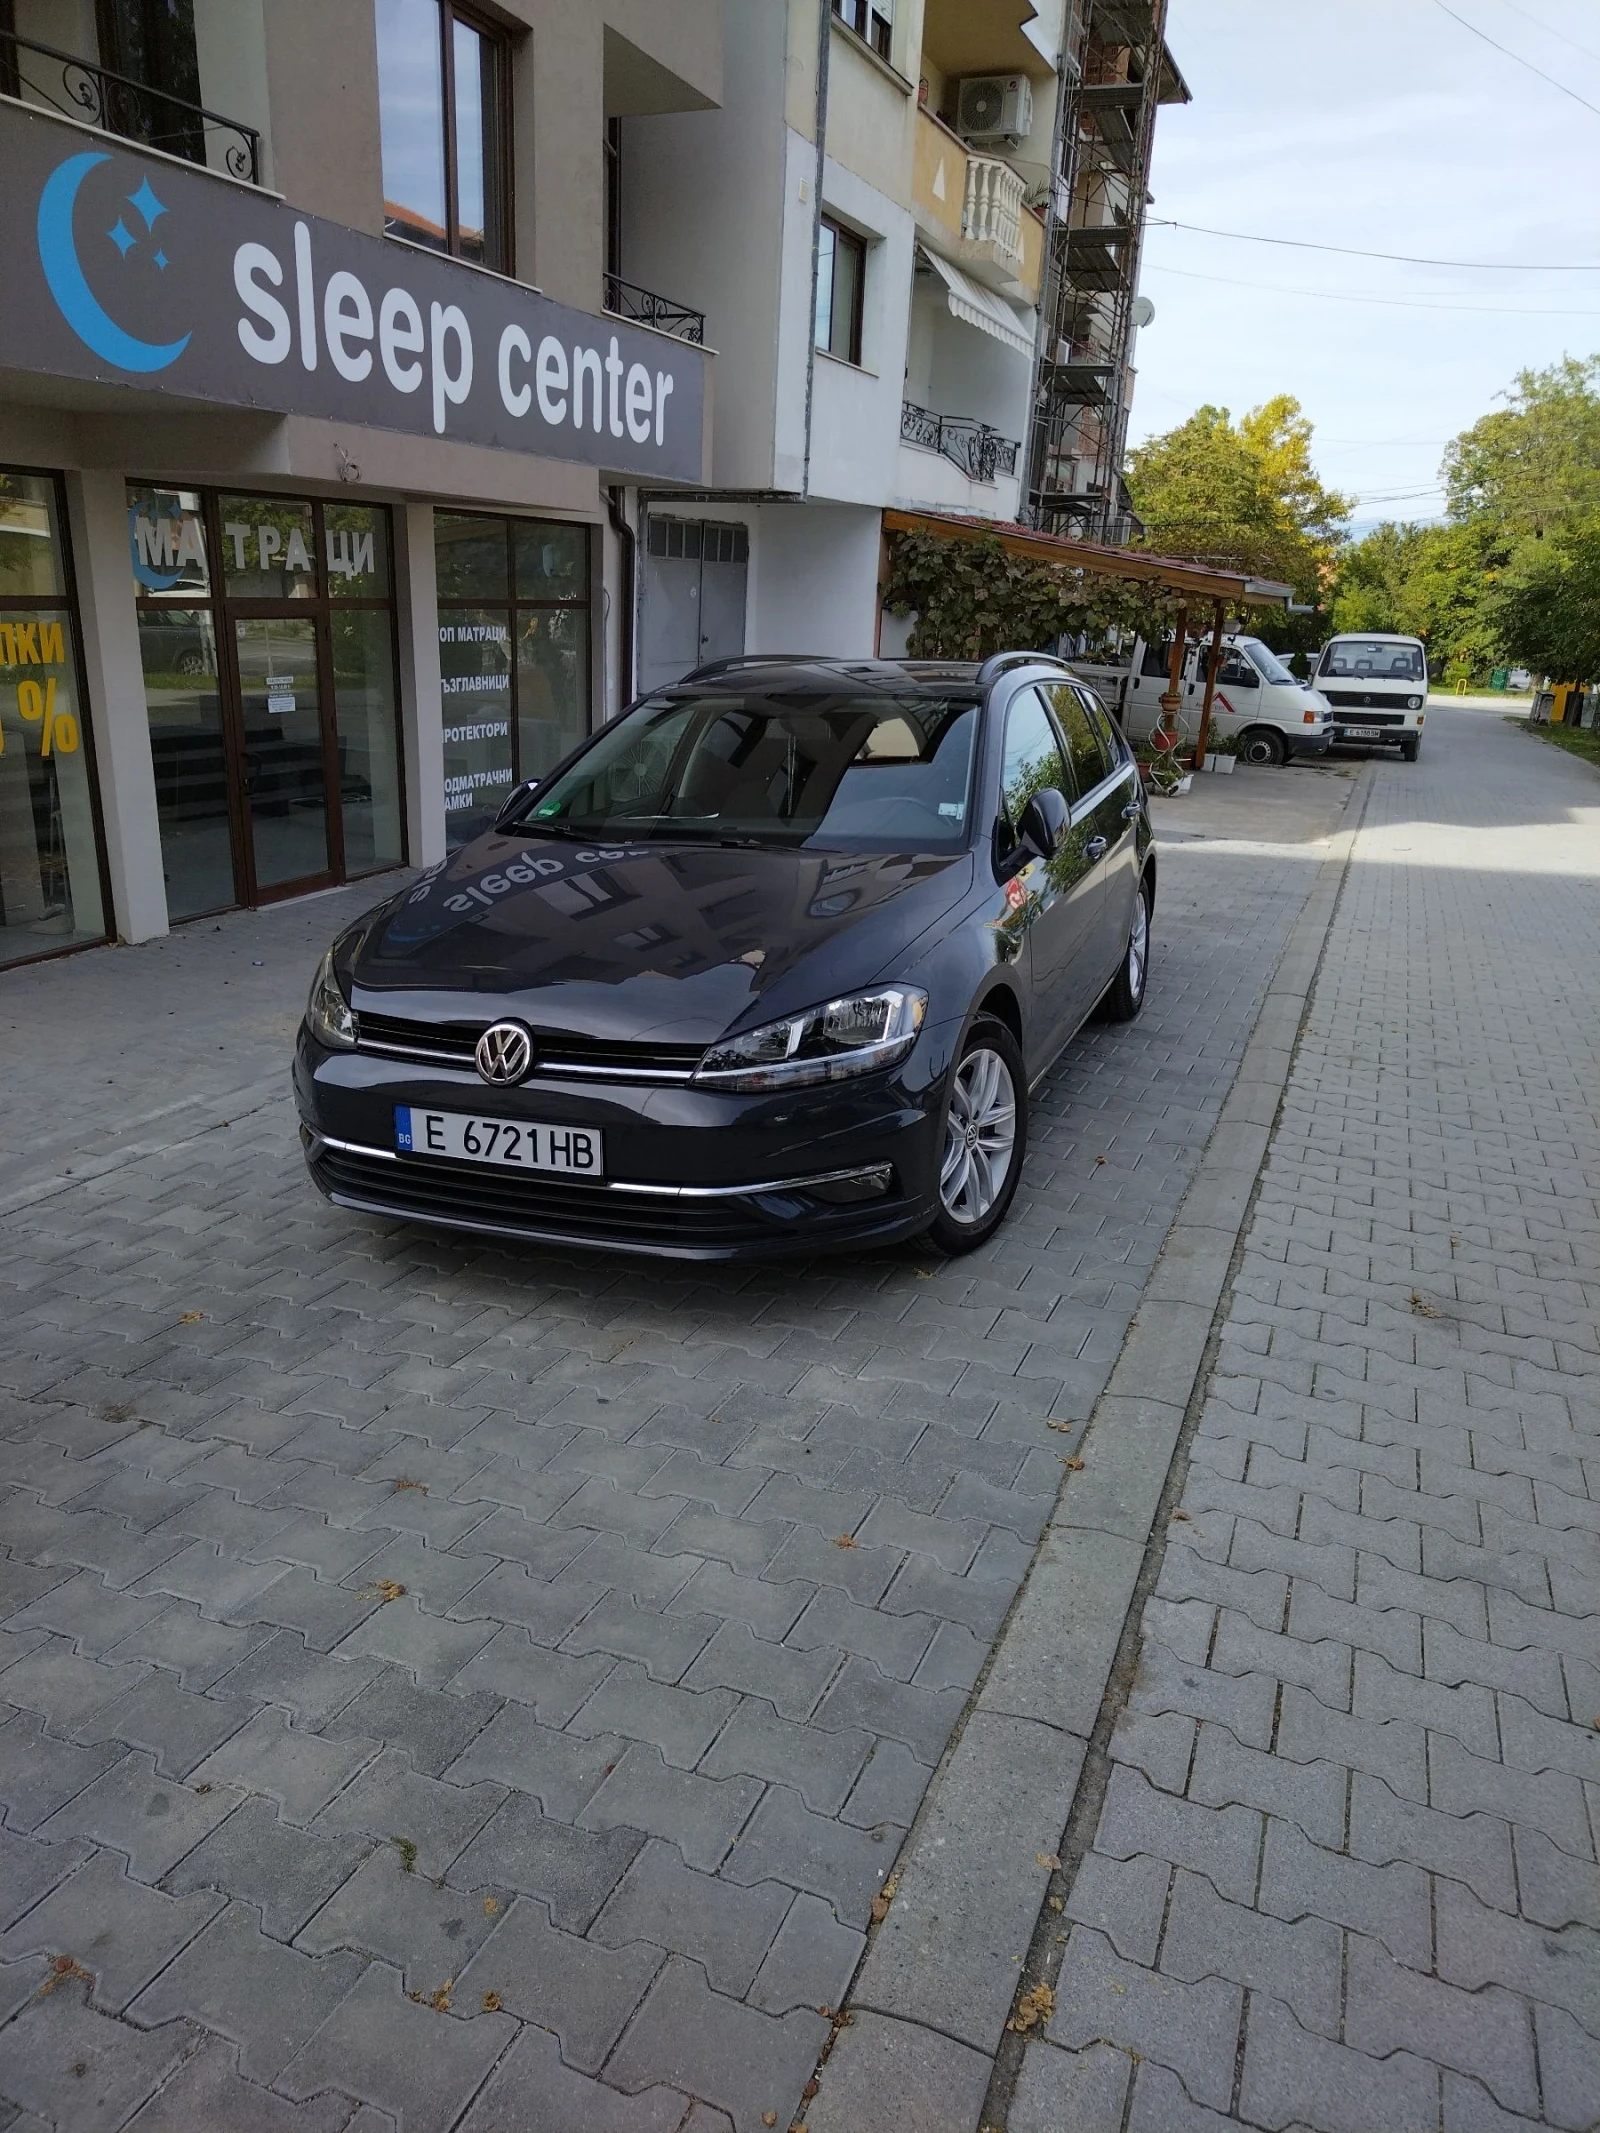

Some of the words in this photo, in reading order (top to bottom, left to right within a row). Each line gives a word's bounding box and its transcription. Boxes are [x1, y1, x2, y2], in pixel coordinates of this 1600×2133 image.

[234, 220, 473, 434] sleep
[498, 323, 675, 447] center
[438, 626, 455, 643] ОП
[457, 626, 507, 644] МАТРАЦИ
[398, 1132, 411, 1145] BG
[425, 1114, 446, 1151] E
